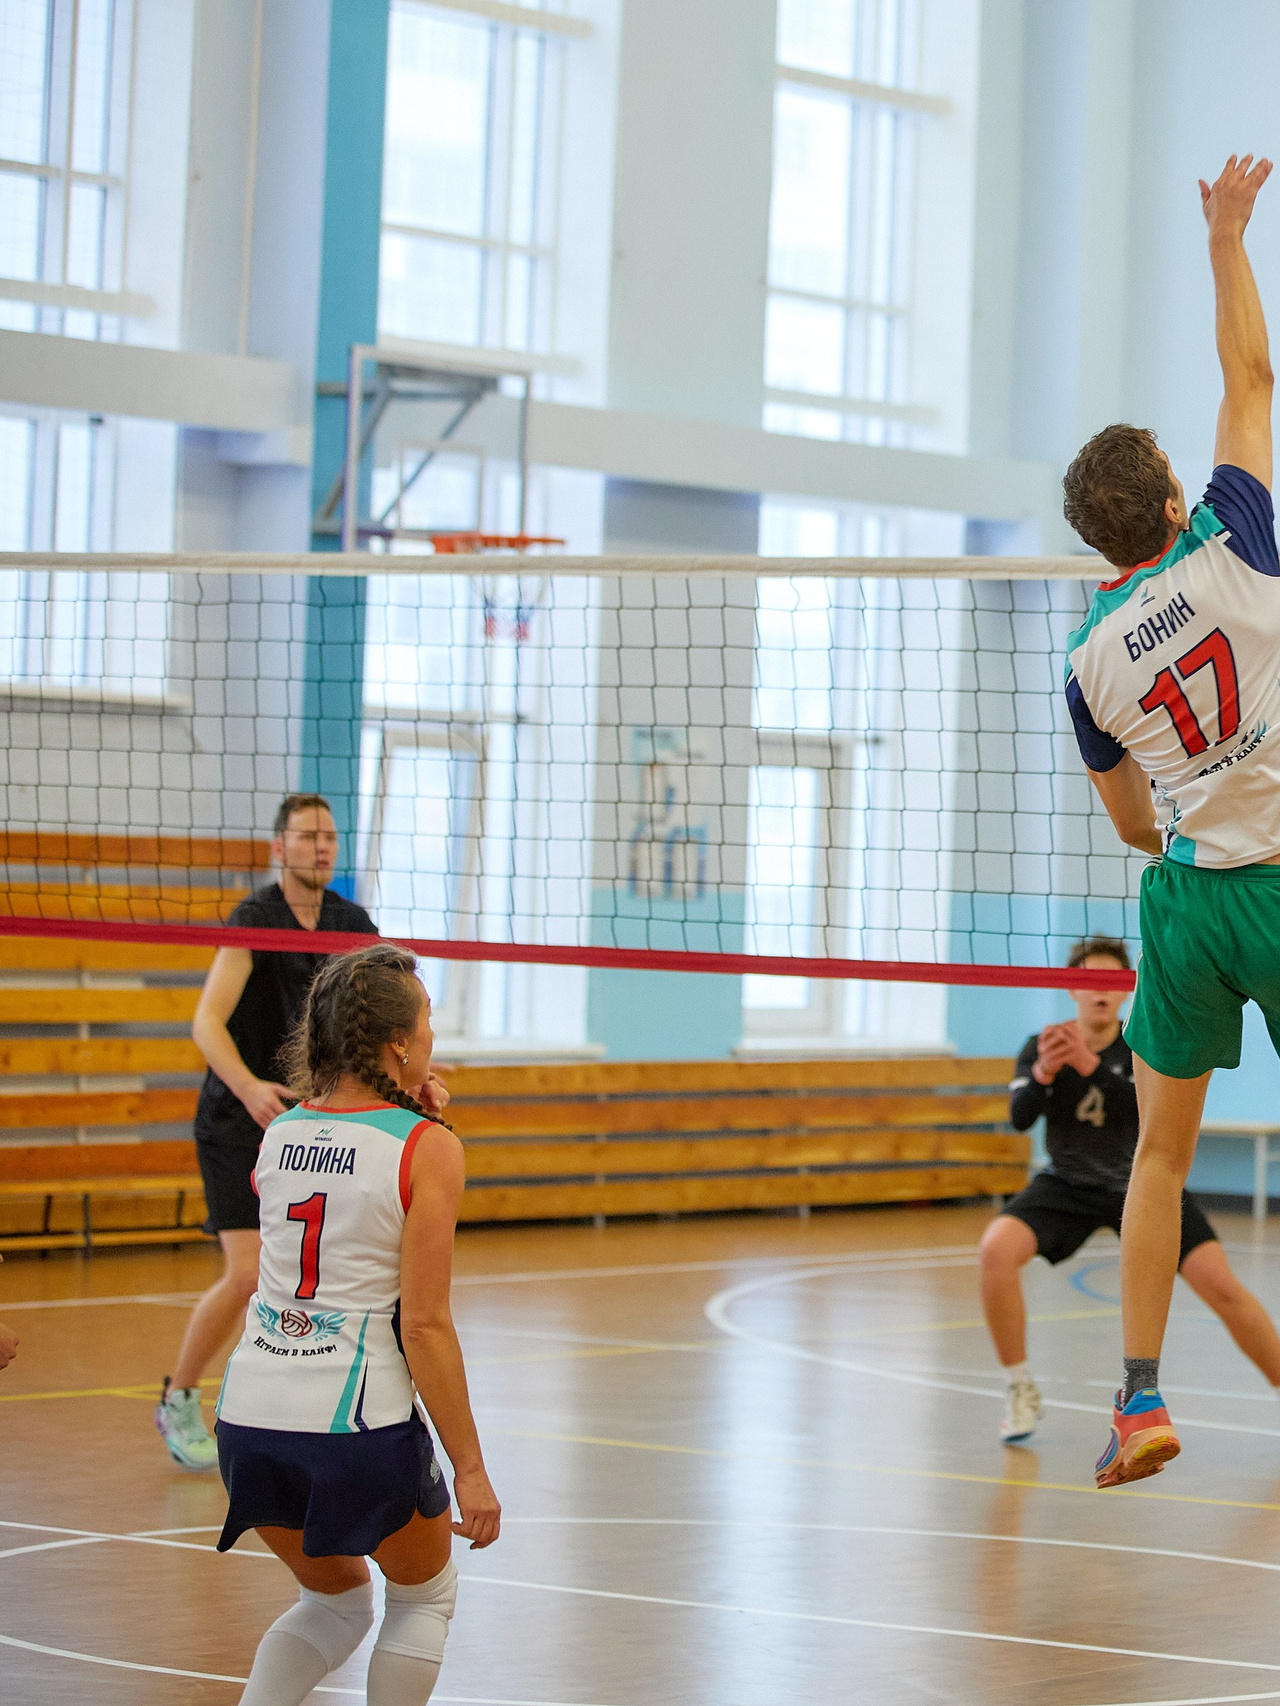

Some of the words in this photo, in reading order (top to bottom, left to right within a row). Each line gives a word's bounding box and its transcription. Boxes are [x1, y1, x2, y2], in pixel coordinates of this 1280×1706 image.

[1123, 592, 1196, 662] БОНИН
[1138, 627, 1241, 760] 17
[1076, 1085, 1106, 1127] 4
[279, 1144, 356, 1175] ПОЛИНА
[287, 1192, 328, 1300] 1
